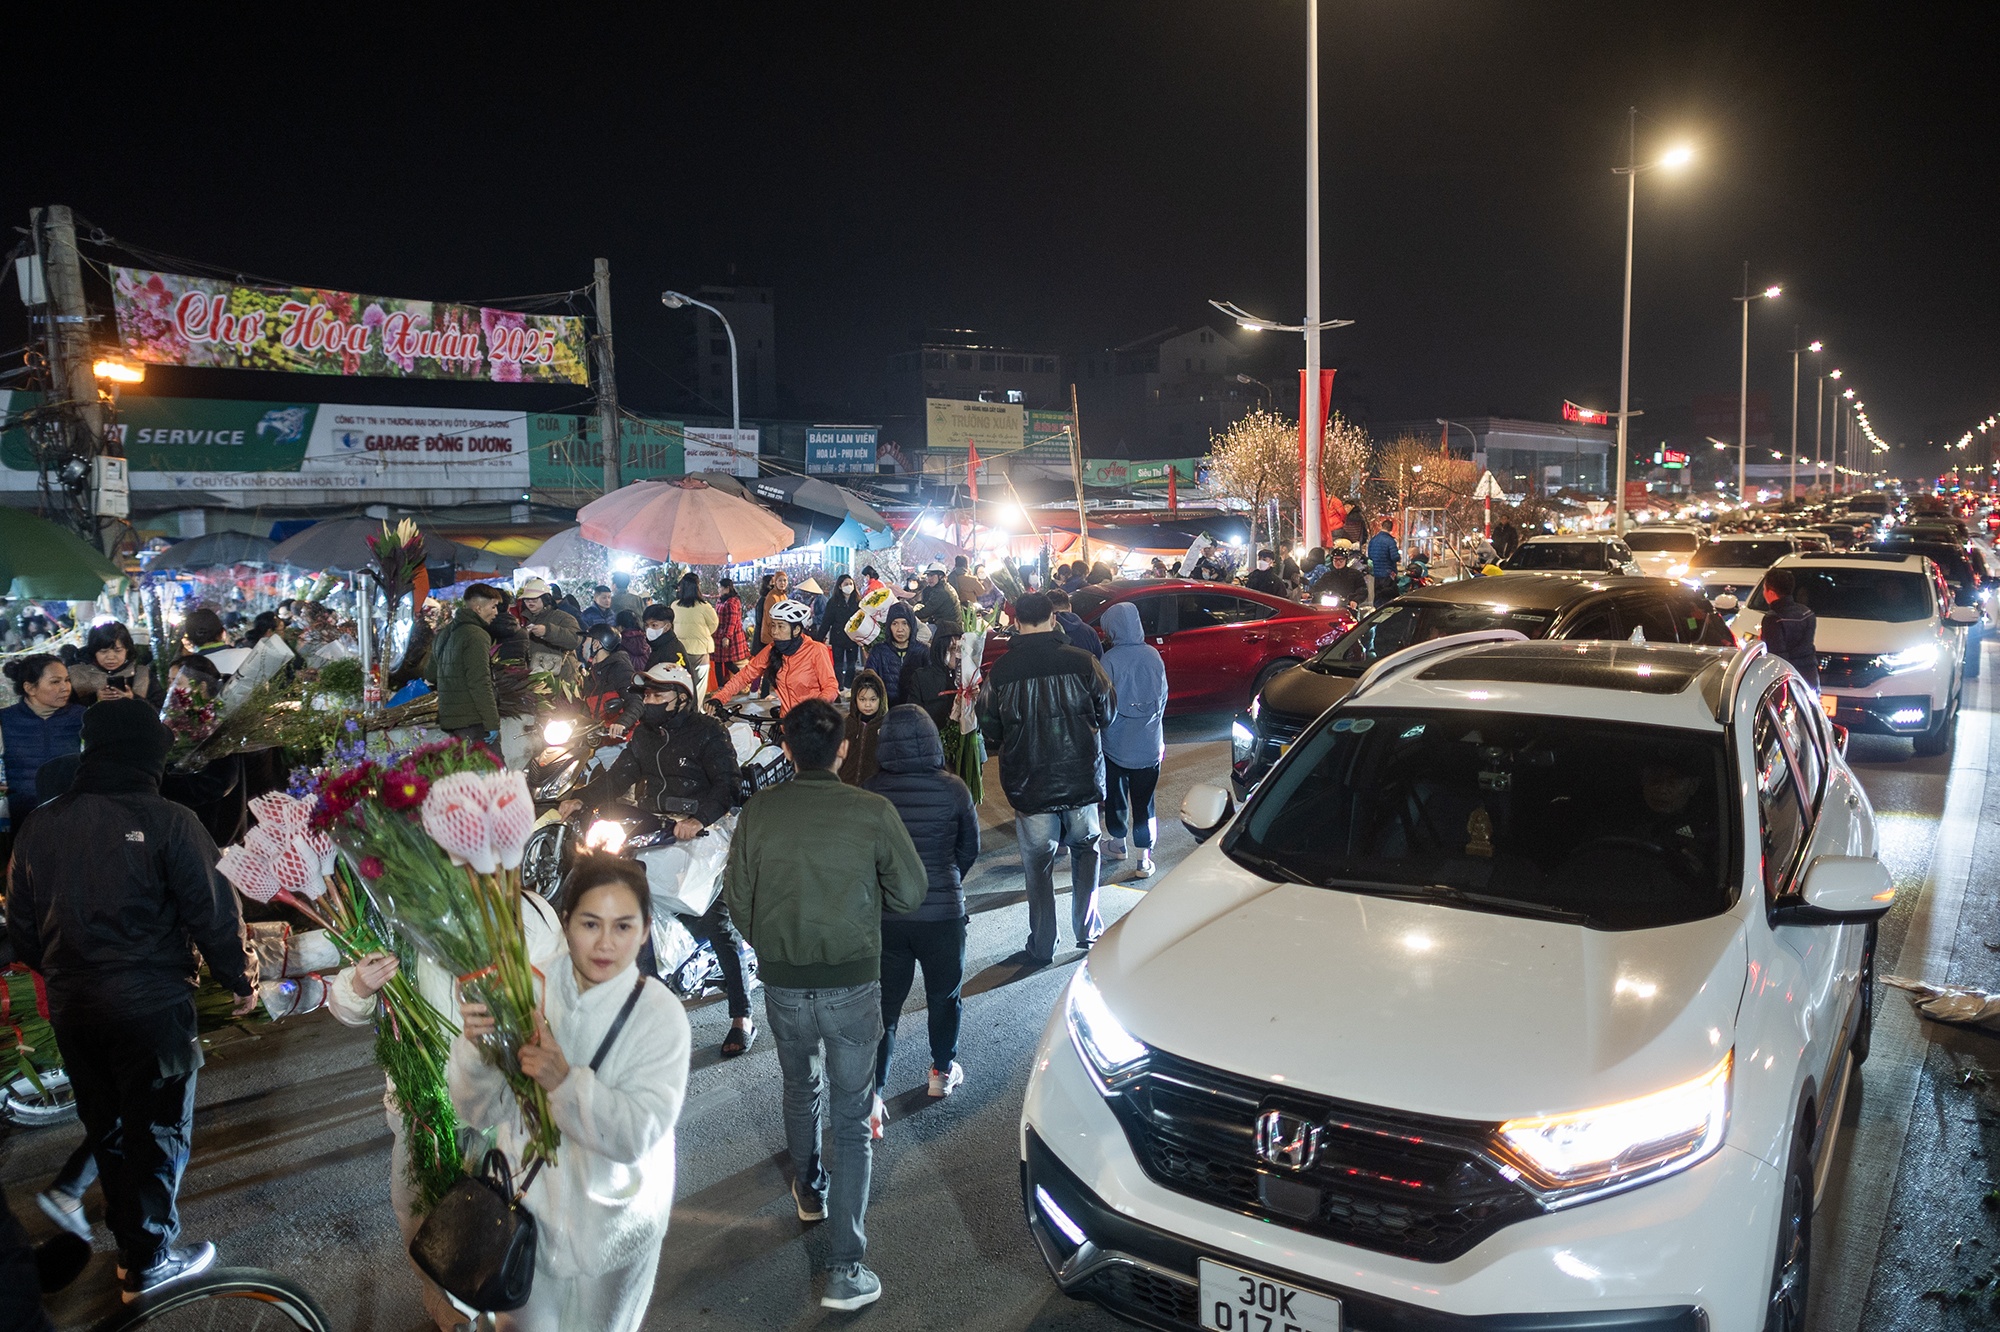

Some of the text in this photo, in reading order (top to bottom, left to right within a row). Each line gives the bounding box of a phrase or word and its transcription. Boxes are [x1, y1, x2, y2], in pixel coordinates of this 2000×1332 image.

[175, 290, 556, 364] Chợ Hoa Xuân 2025
[335, 414, 354, 425] CÔNG
[356, 416, 365, 425] TY
[951, 413, 991, 429] TRƯỜNG
[992, 415, 1018, 430] XUÂN
[136, 427, 245, 446] SERVICE
[365, 433, 512, 453] GARAGE ĐÔNG DƯƠNG
[809, 432, 875, 443] BÁCH LAN VIÊN
[627, 443, 666, 469] ANH
[816, 448, 829, 458] HOA
[829, 447, 837, 458] LÁ
[841, 448, 853, 460] PHỤ
[854, 447, 868, 460] KIỆN
[1138, 468, 1162, 477] Siêu Thị
[193, 475, 238, 487] CHUYÊN
[241, 476, 268, 487] KINH
[269, 476, 308, 488] DOANH
[310, 476, 335, 488] HOA
[1238, 1276, 1297, 1321] 30K
